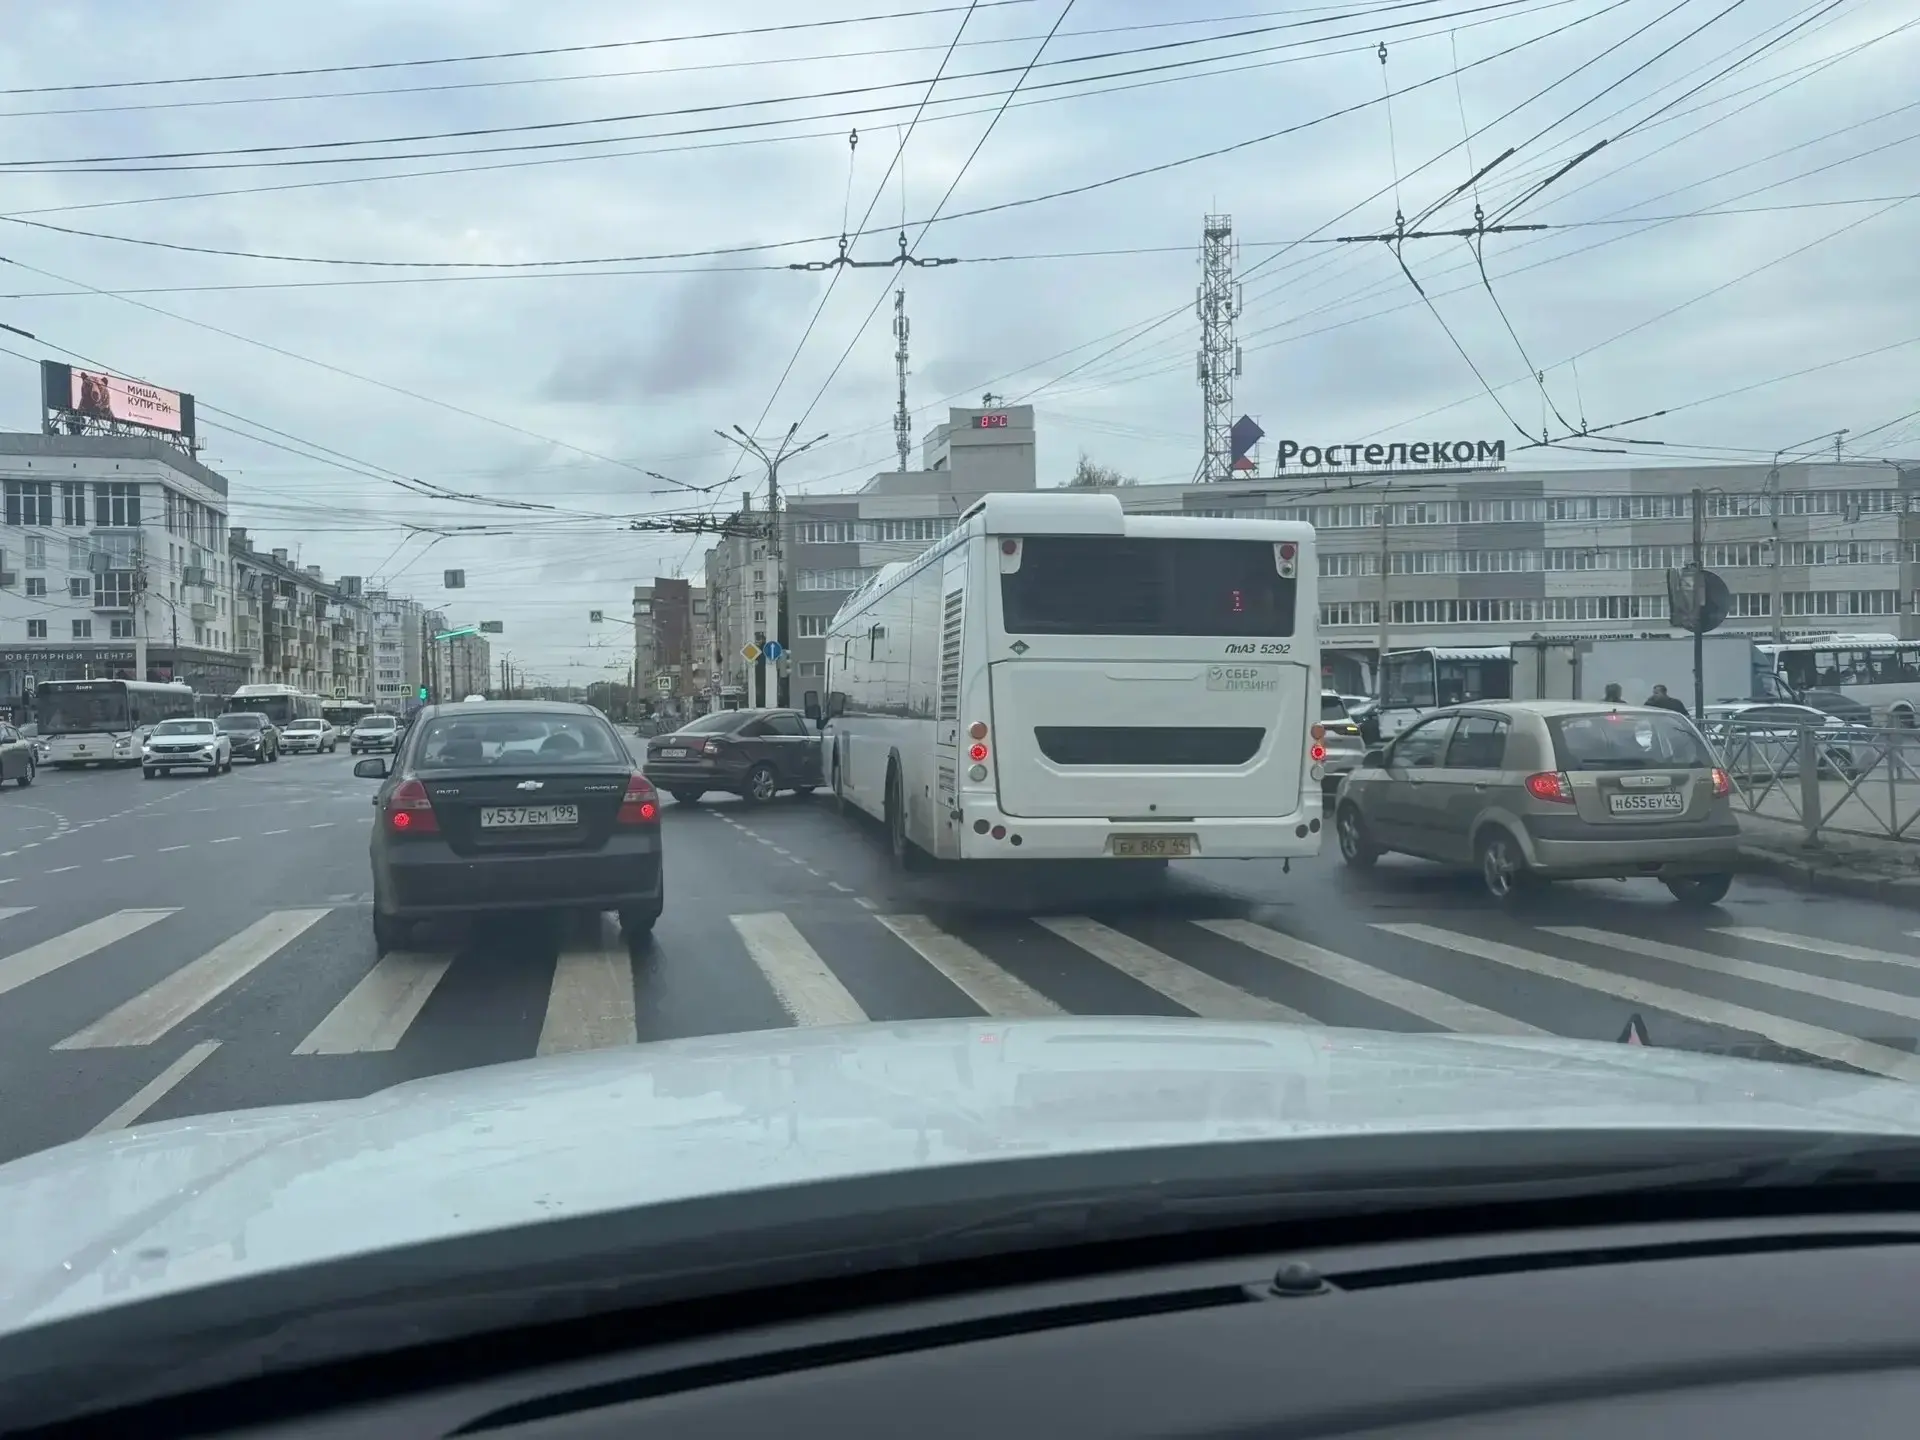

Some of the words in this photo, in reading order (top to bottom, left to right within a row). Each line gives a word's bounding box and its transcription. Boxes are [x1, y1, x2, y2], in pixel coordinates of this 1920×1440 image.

[127, 385, 161, 401] МИША,
[127, 397, 154, 411] КУПИ
[156, 401, 171, 415] ЕЙ!
[1278, 439, 1505, 468] Ростелеком
[1260, 643, 1291, 654] 5292
[95, 652, 133, 660] ЦЕНТР
[1225, 668, 1258, 679] СБЕР
[1225, 680, 1277, 692] ЛИЗИНГ
[486, 808, 549, 824] У537ЕМ
[552, 806, 574, 818] 199
